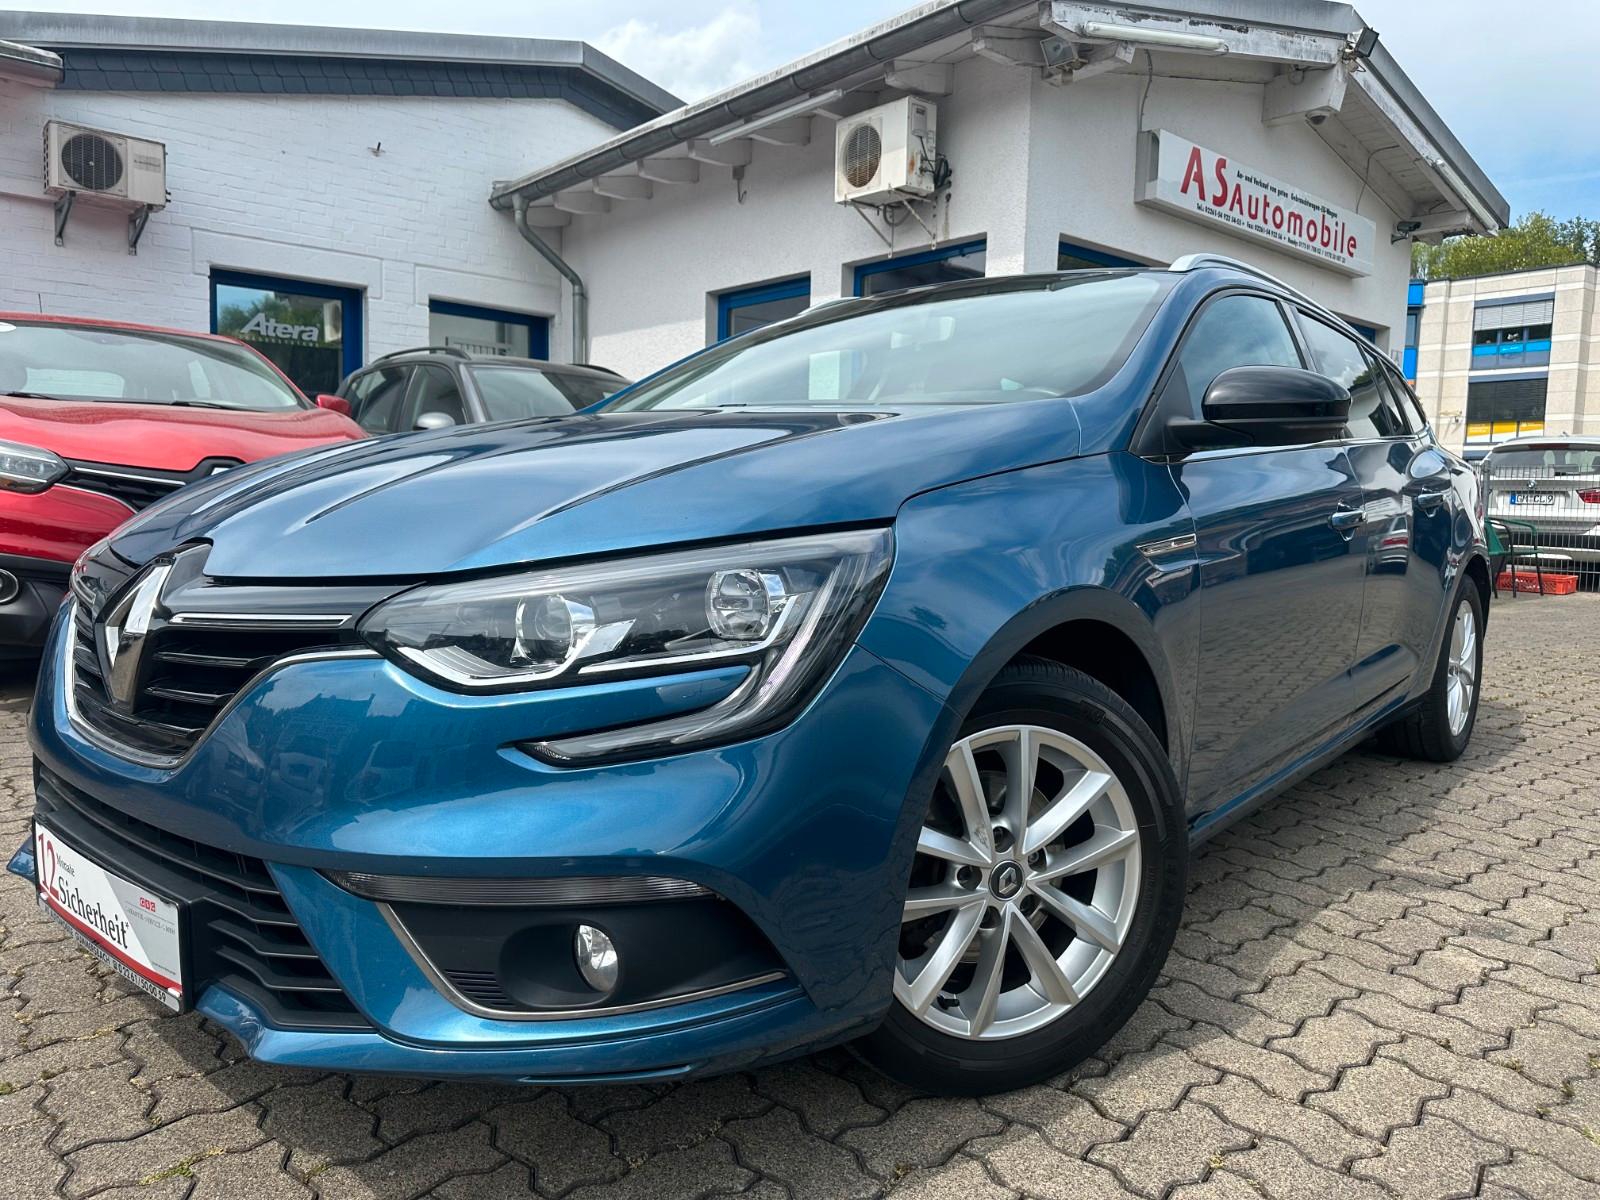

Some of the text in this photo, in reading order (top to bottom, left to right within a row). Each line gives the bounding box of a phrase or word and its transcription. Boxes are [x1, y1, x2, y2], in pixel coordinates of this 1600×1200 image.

[1228, 183, 1357, 257] Automobile
[240, 312, 319, 342] Atera
[38, 833, 60, 902] 12
